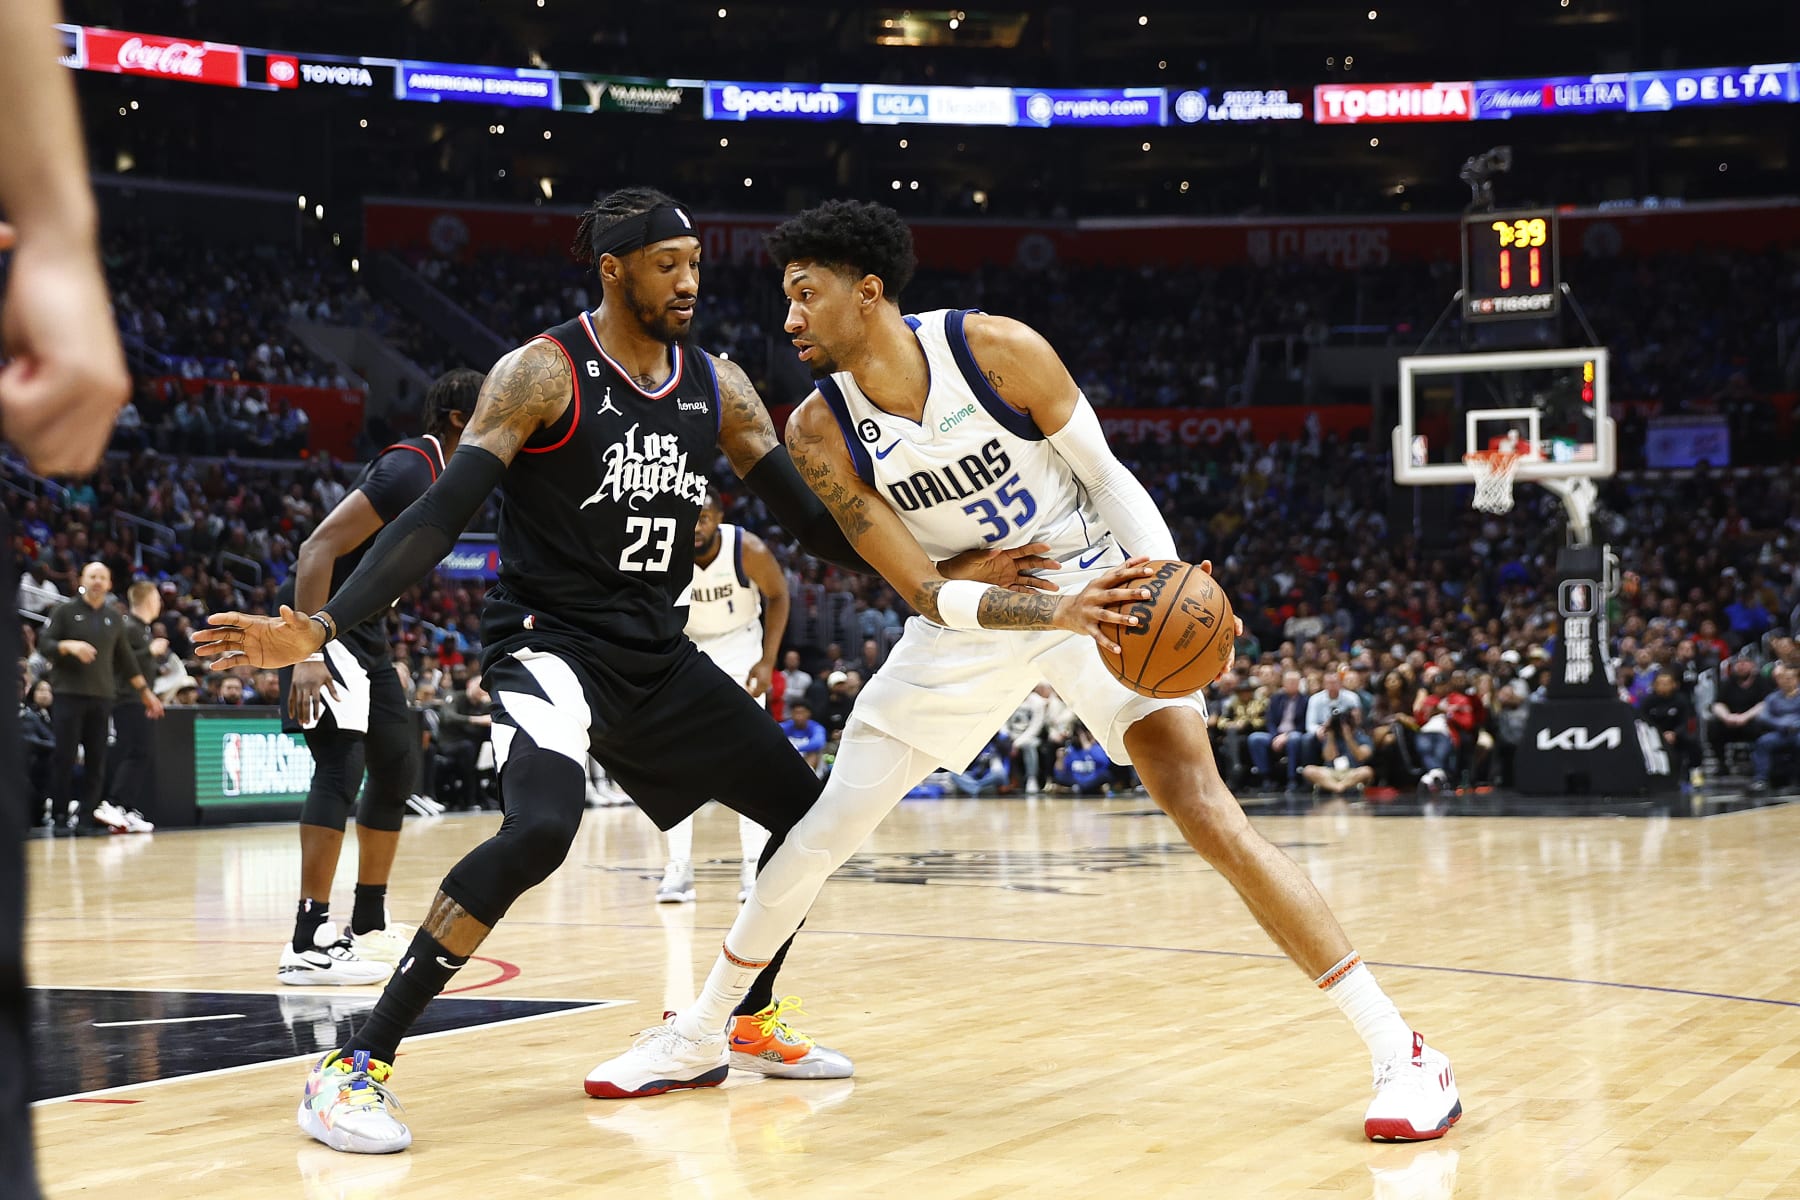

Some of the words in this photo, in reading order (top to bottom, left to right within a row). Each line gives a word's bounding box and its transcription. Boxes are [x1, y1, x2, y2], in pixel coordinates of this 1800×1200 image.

[301, 64, 373, 86] TOYOTA
[408, 73, 483, 92] AMERICAN
[484, 79, 548, 97] EXPRESS
[1675, 74, 1783, 101] DELTA
[722, 86, 839, 113] Spectrum
[876, 95, 925, 114] UCLA
[1323, 89, 1466, 118] TOSHIBA
[1555, 83, 1625, 106] ULTRA
[1053, 99, 1149, 118] crypto.com
[1208, 104, 1228, 120] LA
[1492, 218, 1546, 248] 7:39
[1499, 247, 1540, 289] 11
[586, 360, 600, 377] 6
[677, 398, 708, 414] honey
[939, 403, 977, 433] chime
[862, 422, 876, 440] 6
[623, 423, 678, 465] Los
[580, 452, 708, 511] Angeles
[887, 438, 1011, 511] DALLAS
[961, 472, 1037, 543] 35
[619, 516, 677, 572] 23
[691, 583, 733, 602] ALLAS
[727, 600, 734, 614] 1
